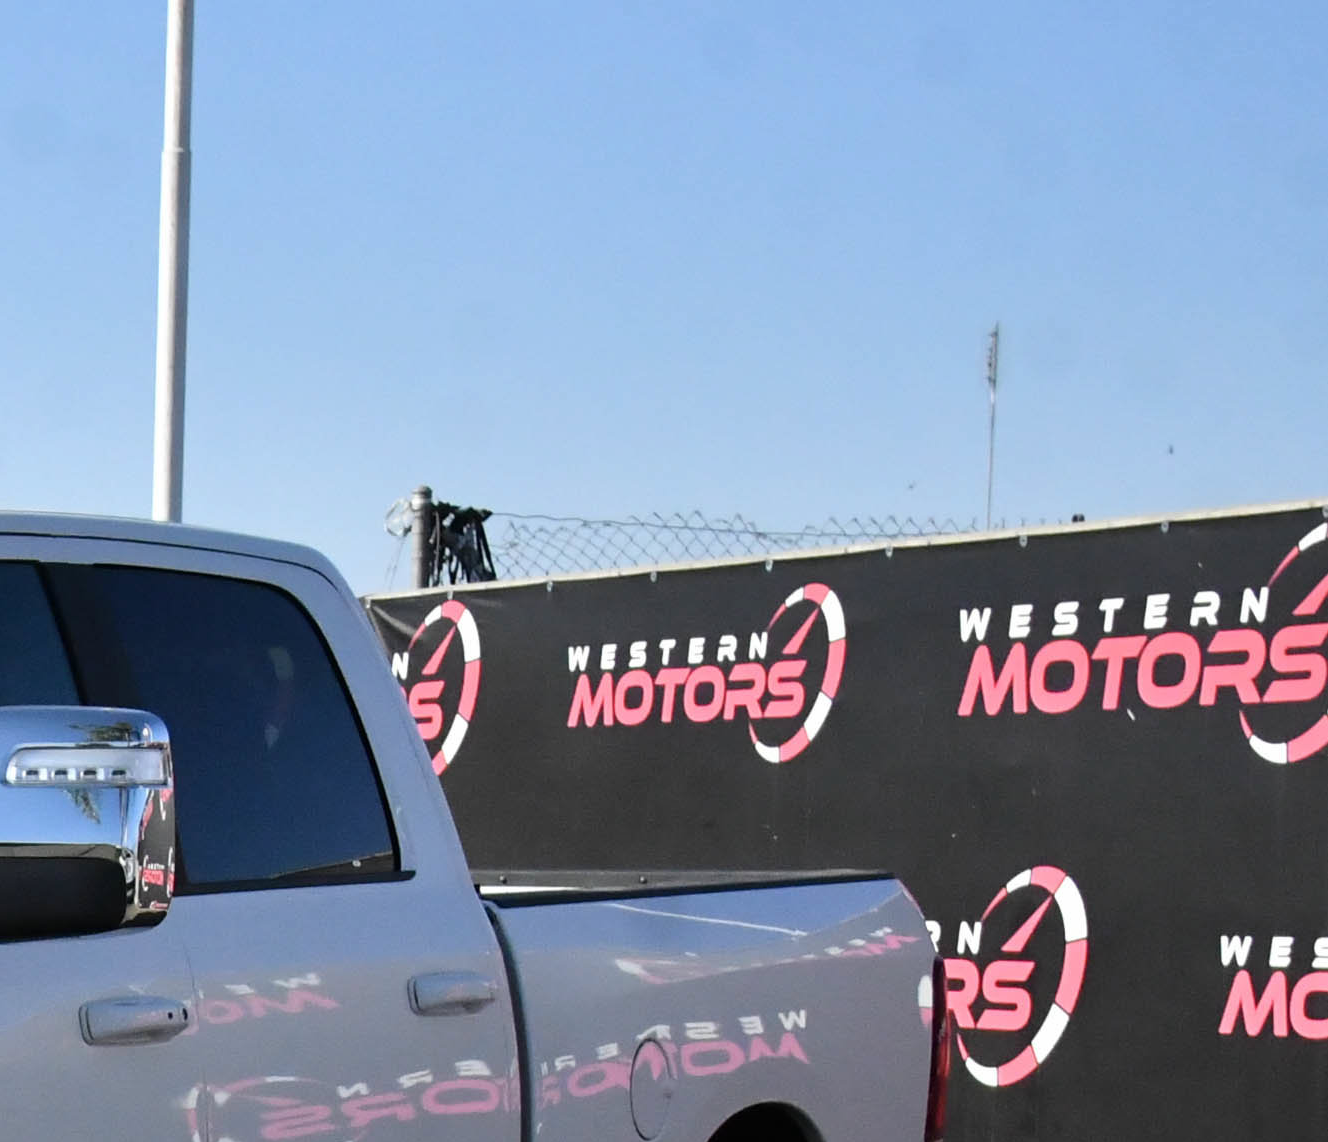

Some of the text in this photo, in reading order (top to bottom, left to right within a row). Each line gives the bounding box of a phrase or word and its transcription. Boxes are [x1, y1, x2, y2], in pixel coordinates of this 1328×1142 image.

[959, 587, 1269, 642] WESTERN
[568, 631, 768, 672] WESTERN
[957, 622, 1328, 716] MOTORS
[567, 660, 808, 728] MOTORS
[1220, 934, 1328, 969] WES
